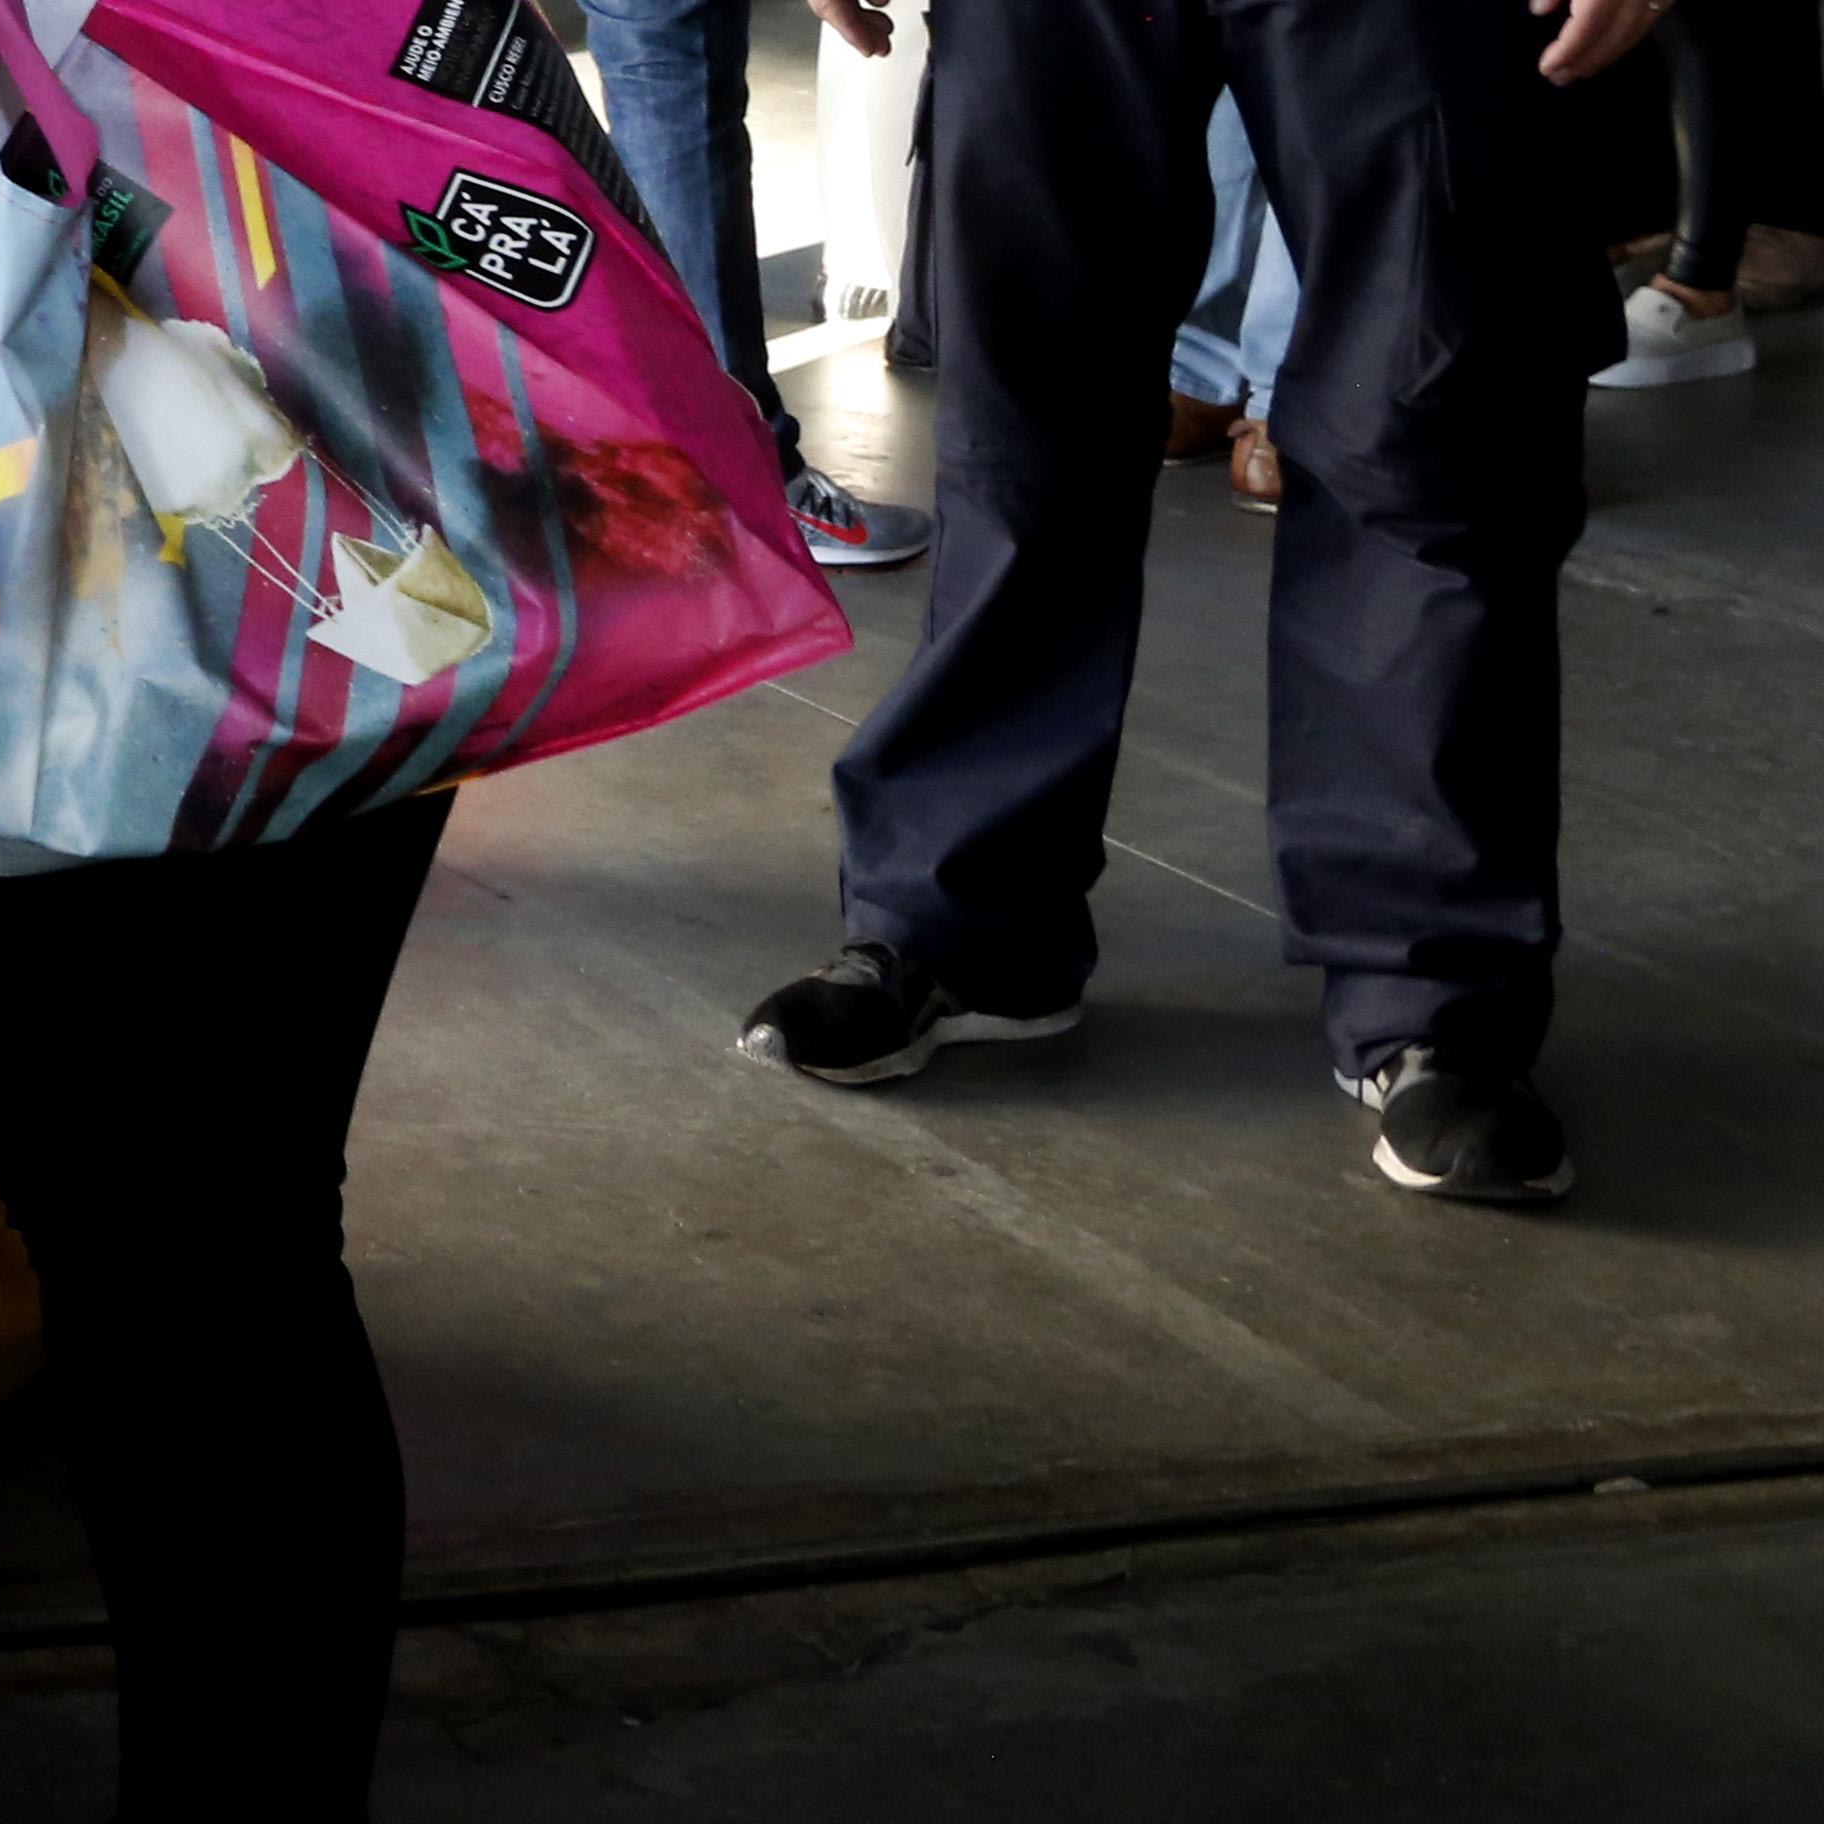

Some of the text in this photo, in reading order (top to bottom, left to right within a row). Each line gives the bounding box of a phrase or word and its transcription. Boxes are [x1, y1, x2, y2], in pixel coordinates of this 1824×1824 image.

[399, 25, 434, 76] AJUDE O
[488, 63, 516, 104] CUSCO
[450, 191, 499, 242] CÁ
[479, 216, 538, 280] PRA
[527, 219, 578, 275] LÁ
